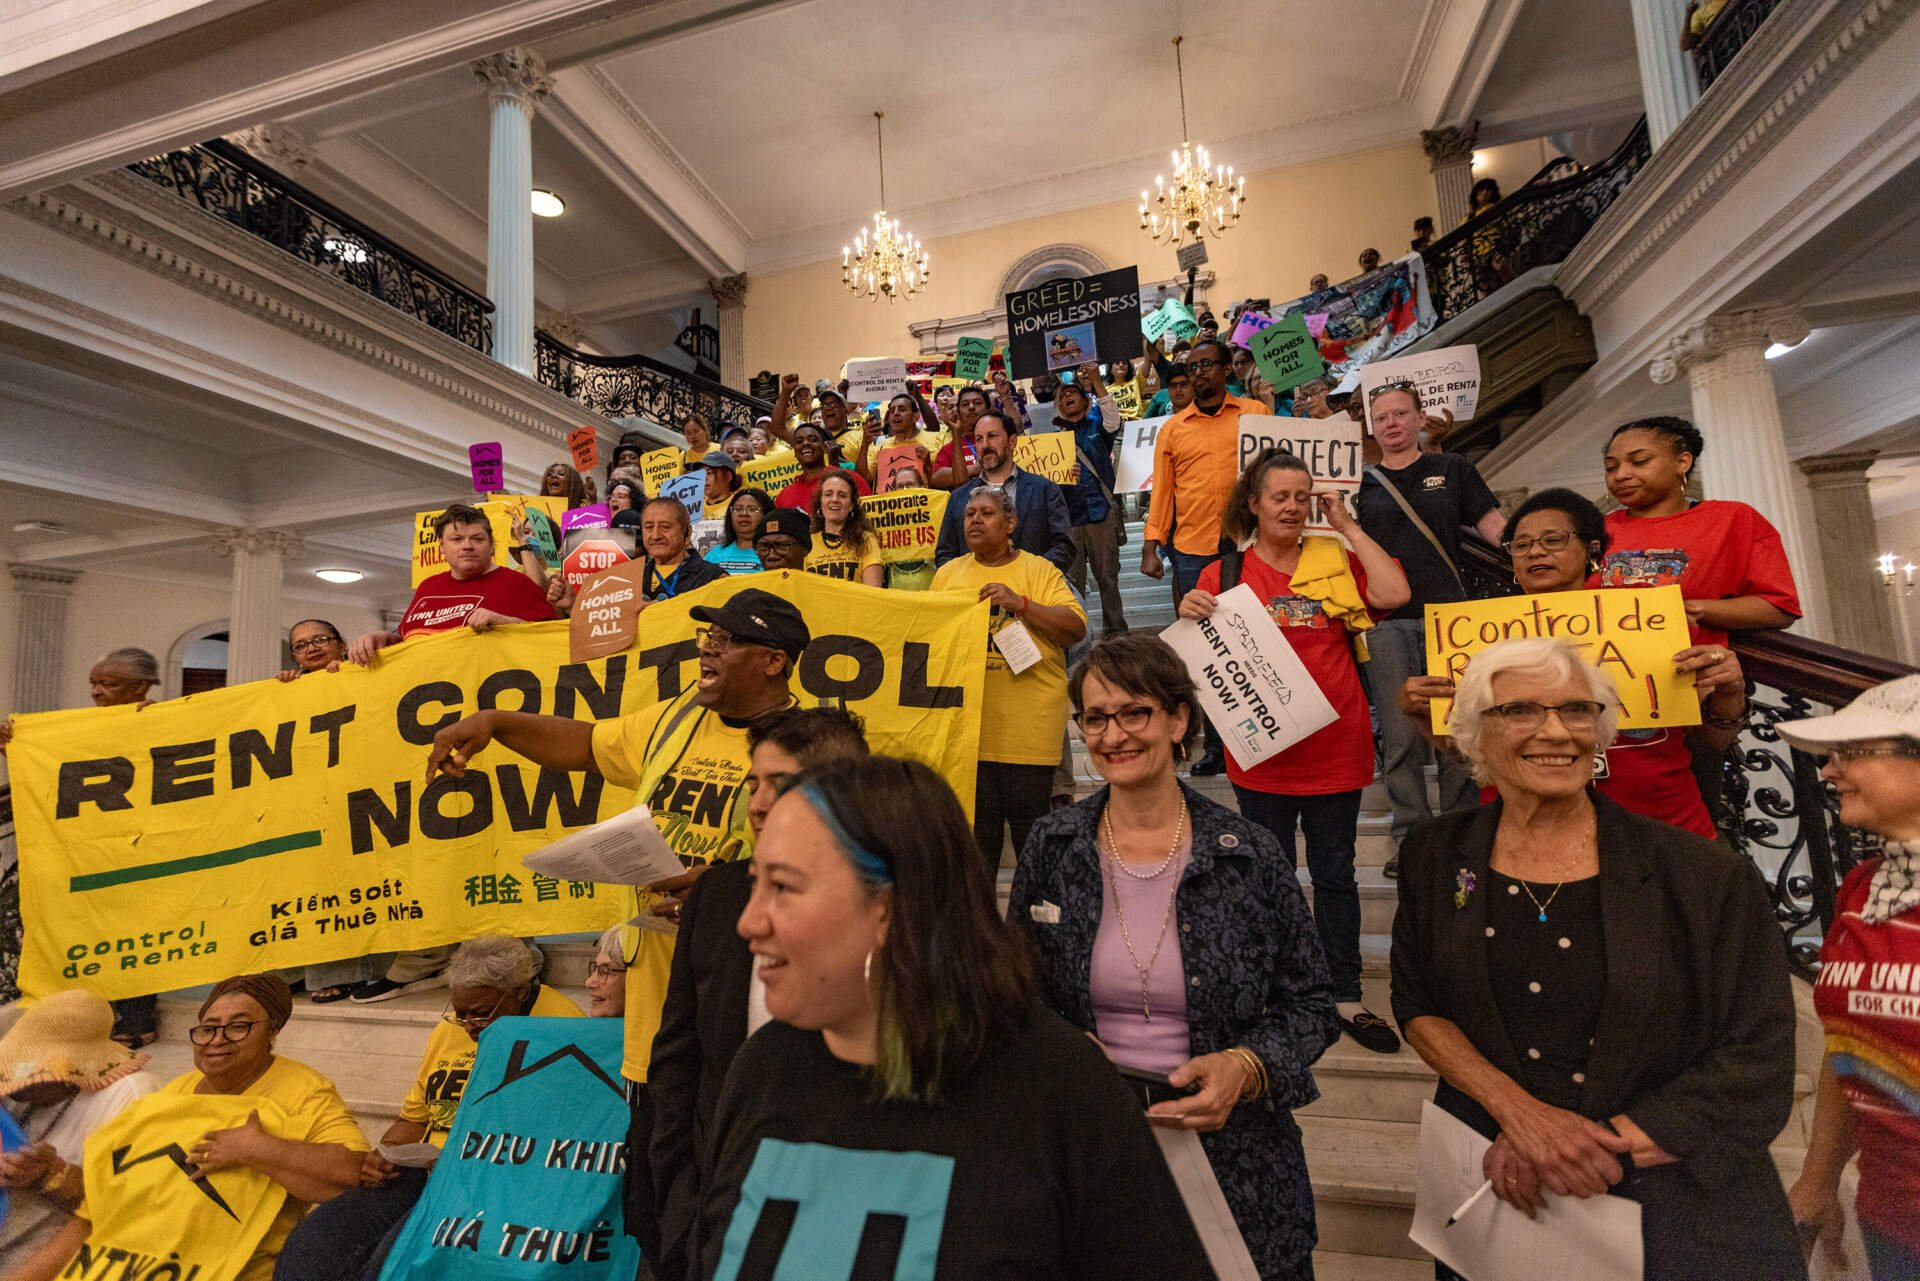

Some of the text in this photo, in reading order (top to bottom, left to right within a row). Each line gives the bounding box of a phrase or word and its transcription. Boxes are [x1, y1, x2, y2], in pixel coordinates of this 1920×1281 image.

[1010, 280, 1085, 316] GREED
[1014, 292, 1138, 336] HOMELESSNESS
[959, 350, 988, 359] HOMES
[1263, 335, 1305, 361] HOMES
[1273, 350, 1299, 367] FOR
[1281, 360, 1304, 376] ALL
[963, 366, 979, 374] ALL
[1429, 385, 1445, 394] DE
[1447, 380, 1477, 391] RENTA
[1421, 396, 1449, 408] ORA!
[572, 438, 594, 452] HOMES
[578, 448, 591, 459] FOR
[473, 459, 500, 468] HOMES
[581, 455, 593, 465] ALL
[1025, 438, 1065, 473] ntrol
[478, 468, 495, 476] FOR
[645, 461, 678, 475] HOMES
[652, 472, 671, 481] FOR
[747, 463, 803, 483] Kontwo
[480, 477, 496, 485] ALL
[670, 485, 699, 501] ACT
[862, 494, 929, 514] orporate
[870, 509, 931, 529] ndlords
[878, 525, 936, 549] LING US
[579, 551, 617, 569] STOP
[580, 588, 634, 610] HOMES
[406, 603, 475, 623] LYNN UNITED
[588, 606, 621, 623] FOR
[1618, 597, 1666, 632] de
[590, 621, 622, 638] ALL
[1226, 612, 1294, 707] SPRINGFIELD
[1196, 617, 1231, 658] RENT
[1225, 659, 1283, 740] CONTROL
[1202, 663, 1240, 713] NOW!
[56, 704, 357, 819] RENT
[397, 634, 964, 746] CONTOL
[348, 764, 604, 855] NOW
[650, 775, 738, 828] REN
[315, 907, 377, 934] Thuê
[67, 920, 206, 961] Control
[62, 941, 218, 979] de Renta
[1816, 961, 1920, 994] YNN UNI
[1855, 994, 1883, 1011] FOR
[425, 1069, 472, 1105] RE
[498, 1220, 615, 1265] THUÊ
